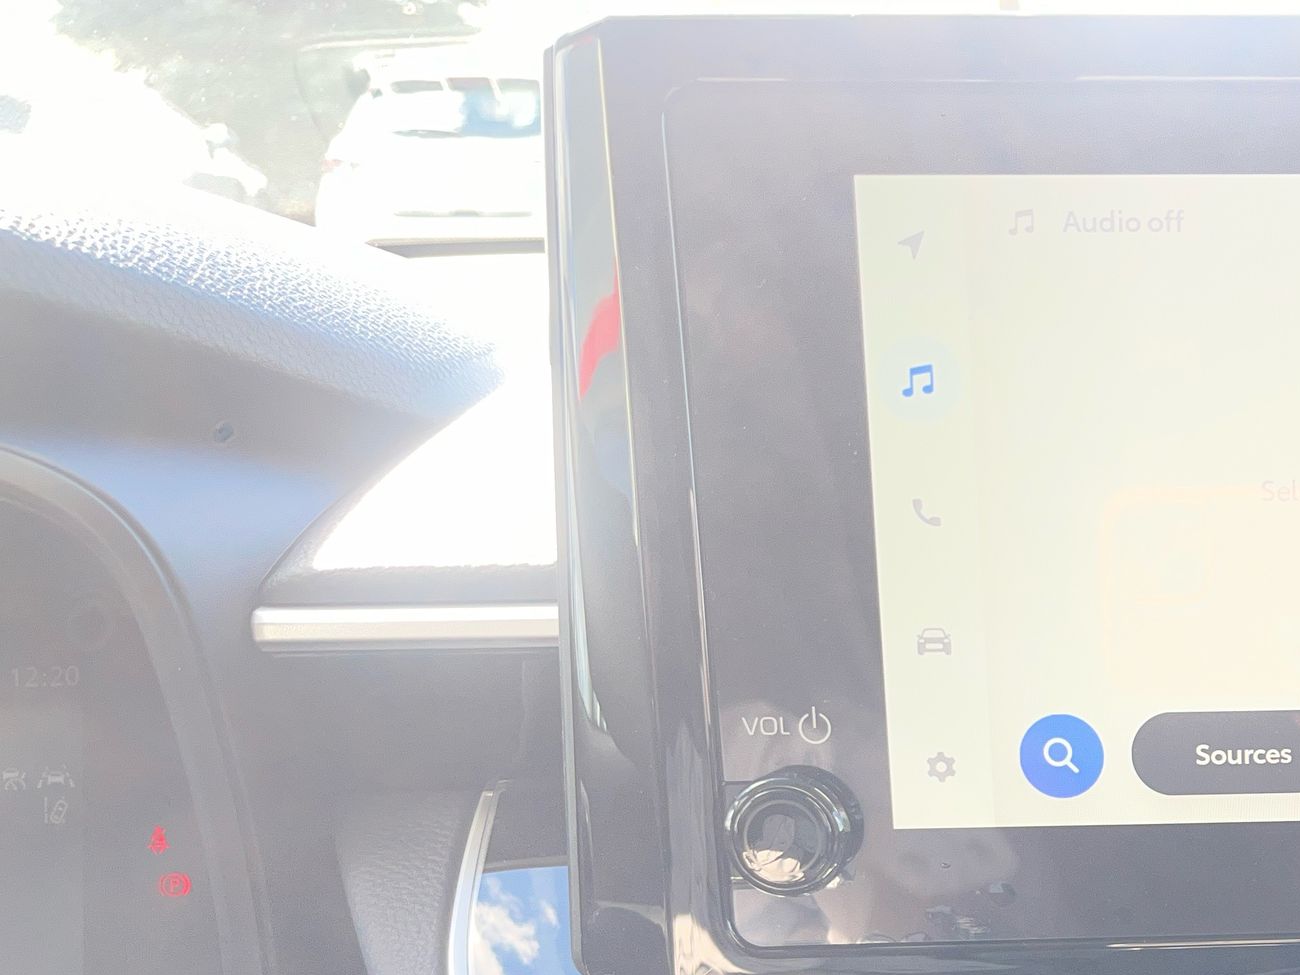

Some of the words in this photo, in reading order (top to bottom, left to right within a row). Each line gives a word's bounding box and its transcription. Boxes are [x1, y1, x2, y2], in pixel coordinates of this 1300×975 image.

[1062, 210, 1143, 234] Audio
[1147, 208, 1184, 234] off
[11, 666, 80, 688] 12:20
[742, 716, 791, 737] VOL
[1195, 743, 1292, 765] Sources
